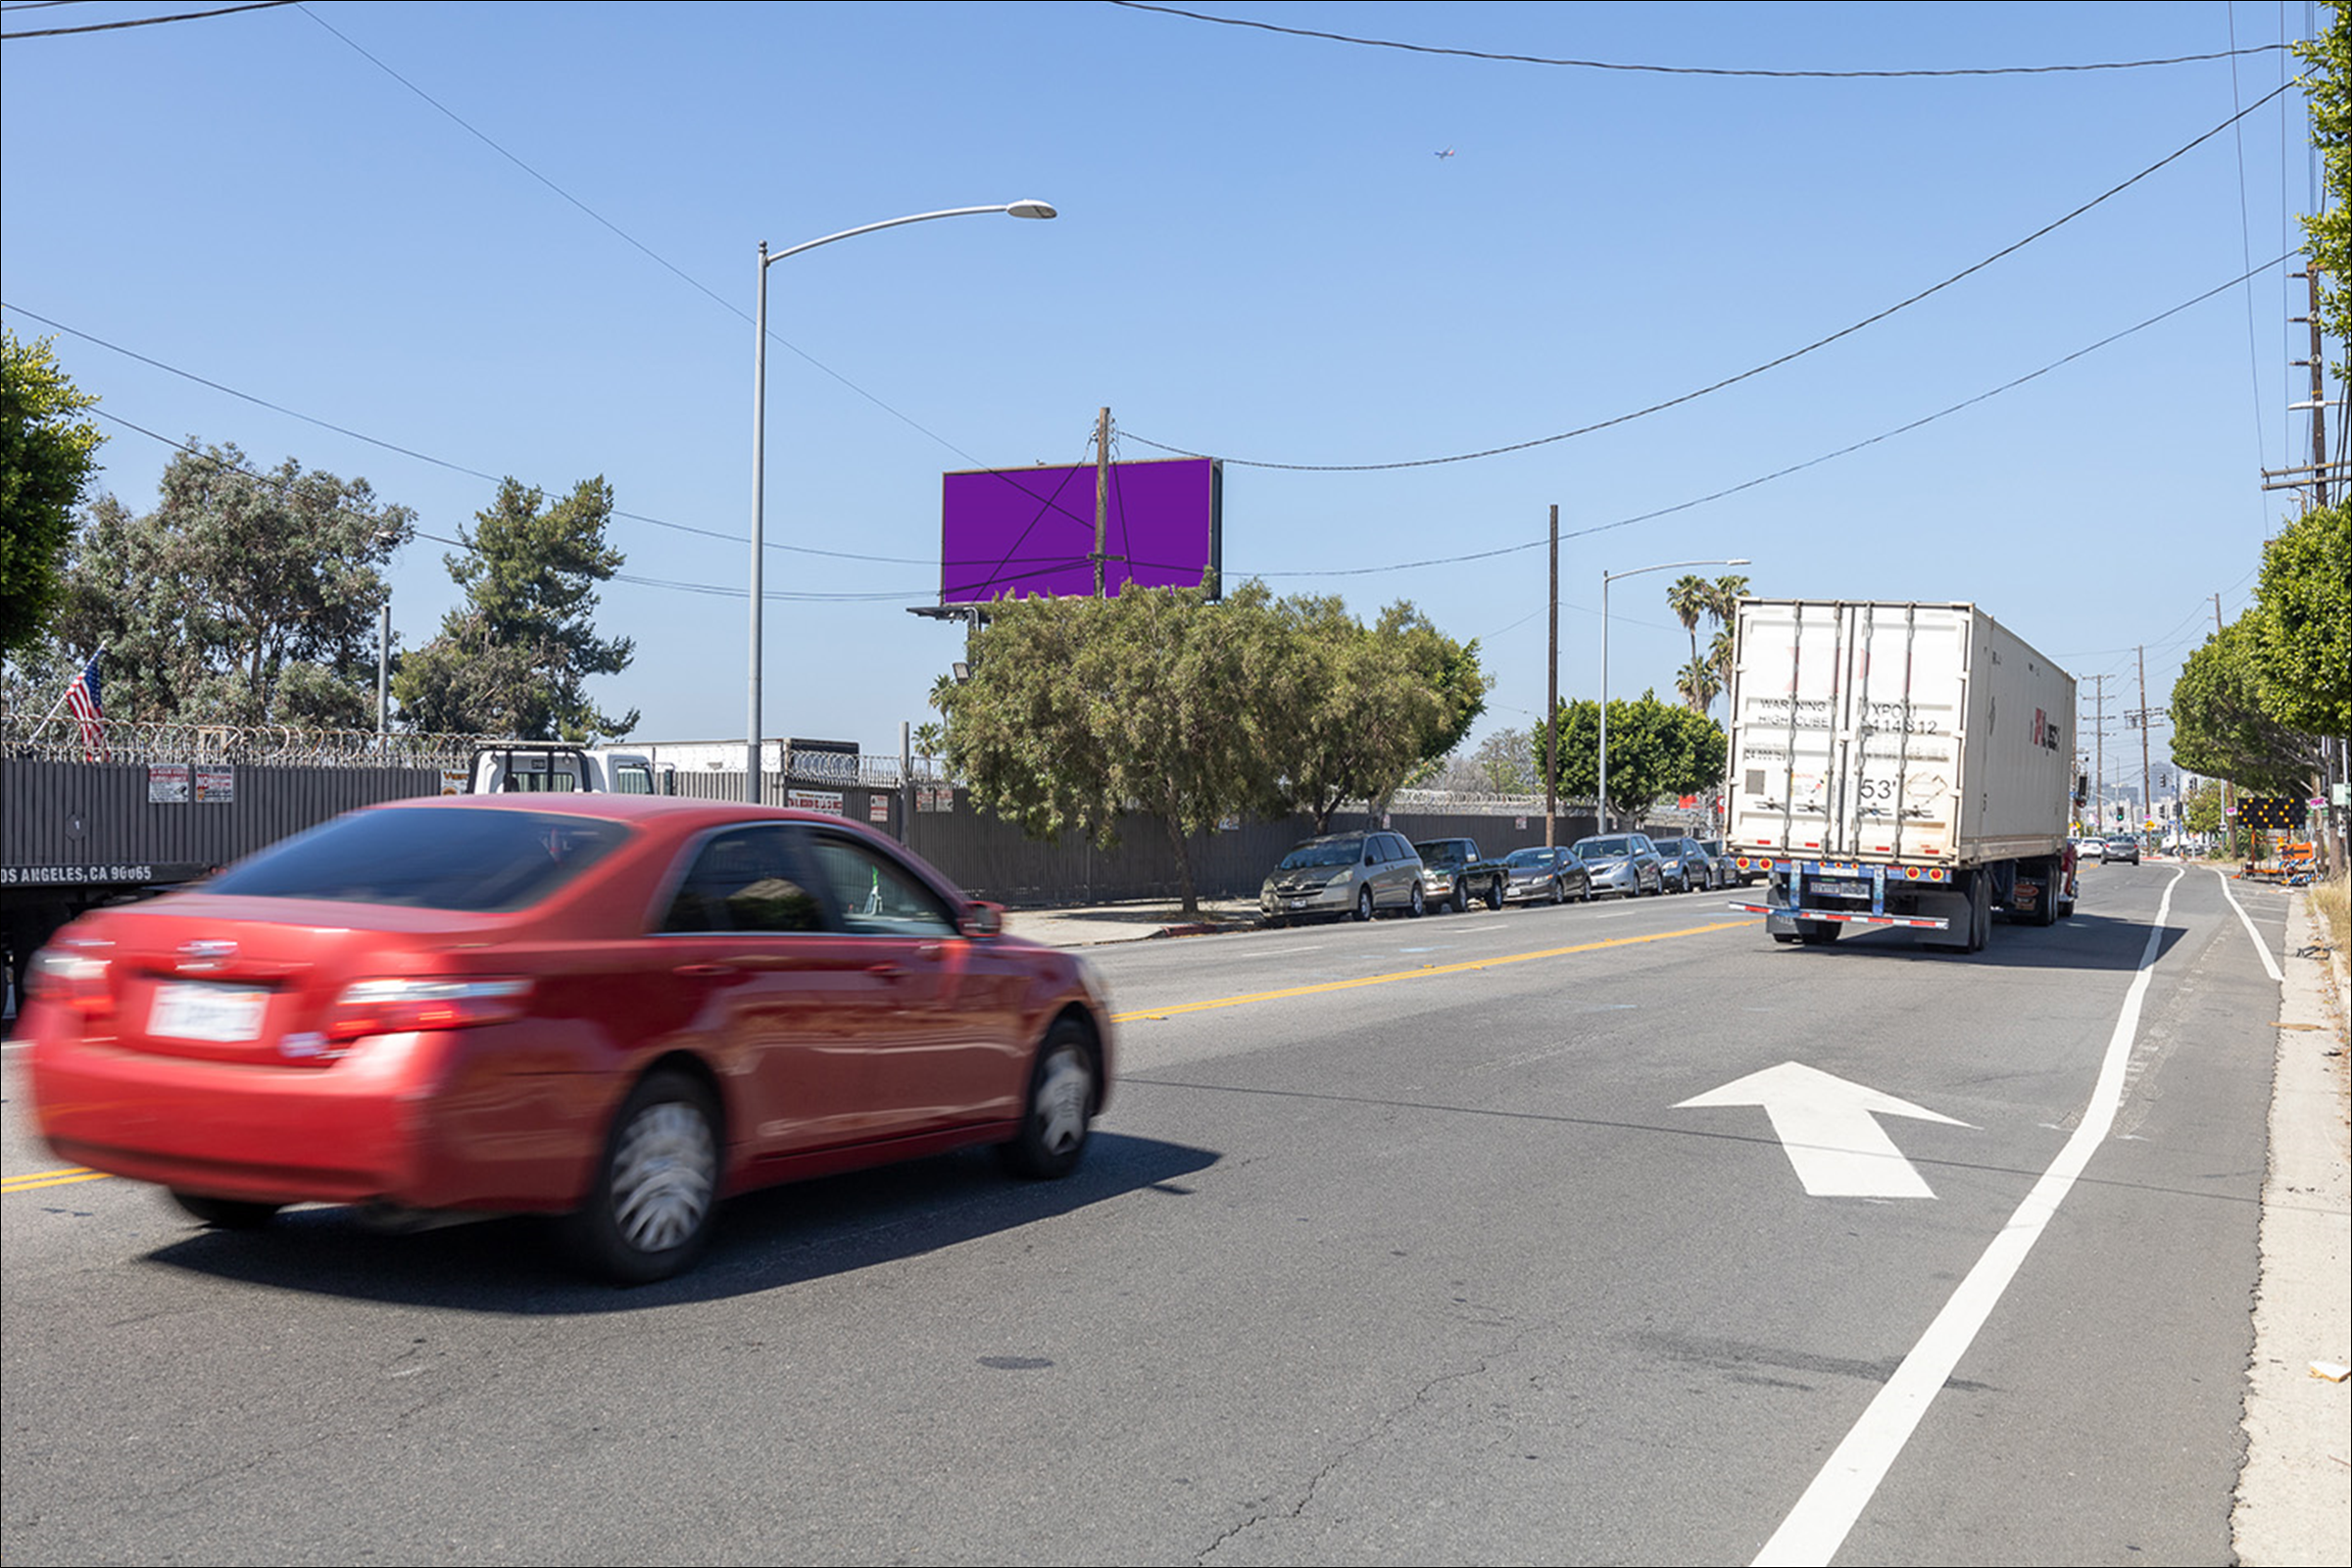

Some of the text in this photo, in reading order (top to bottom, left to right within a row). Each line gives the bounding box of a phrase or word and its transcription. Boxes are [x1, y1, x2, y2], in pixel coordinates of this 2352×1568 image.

[1760, 698, 1827, 712] WARNING
[1757, 714, 1831, 729] HIGH CUBE
[1860, 778, 1897, 800] 53'
[21, 866, 88, 883] ANGELES,
[89, 865, 108, 881] CA
